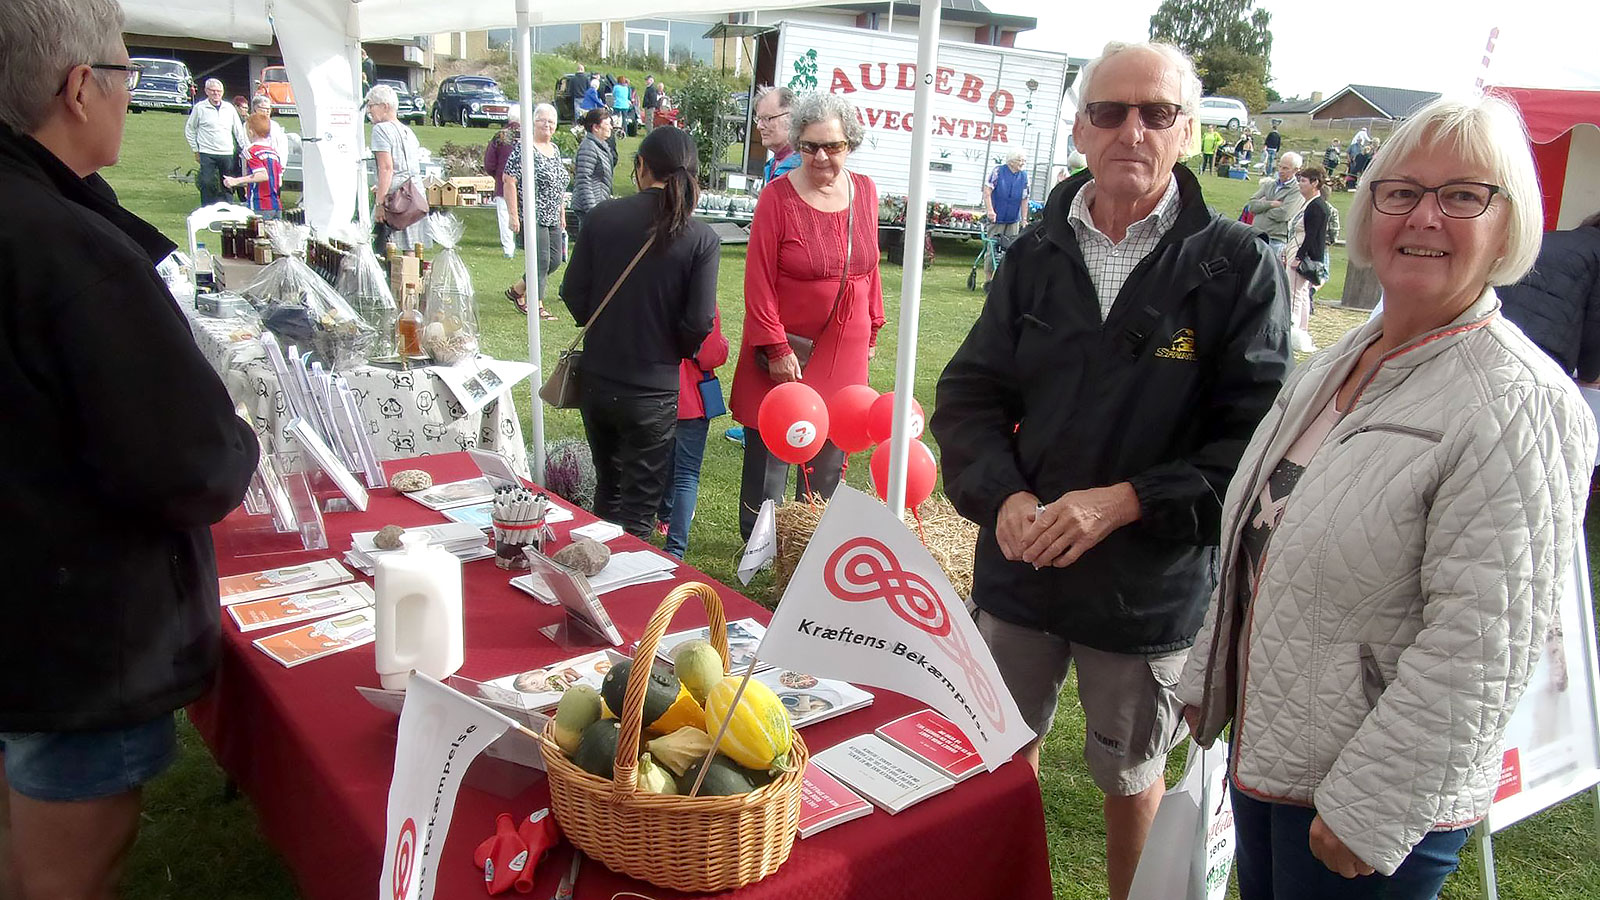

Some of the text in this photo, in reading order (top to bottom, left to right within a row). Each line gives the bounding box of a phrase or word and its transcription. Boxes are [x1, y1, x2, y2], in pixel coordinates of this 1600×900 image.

[829, 62, 1015, 118] AUDEBO
[797, 618, 989, 743] Kræftens Bekæmpelse
[423, 724, 478, 856] Bekæmpelse
